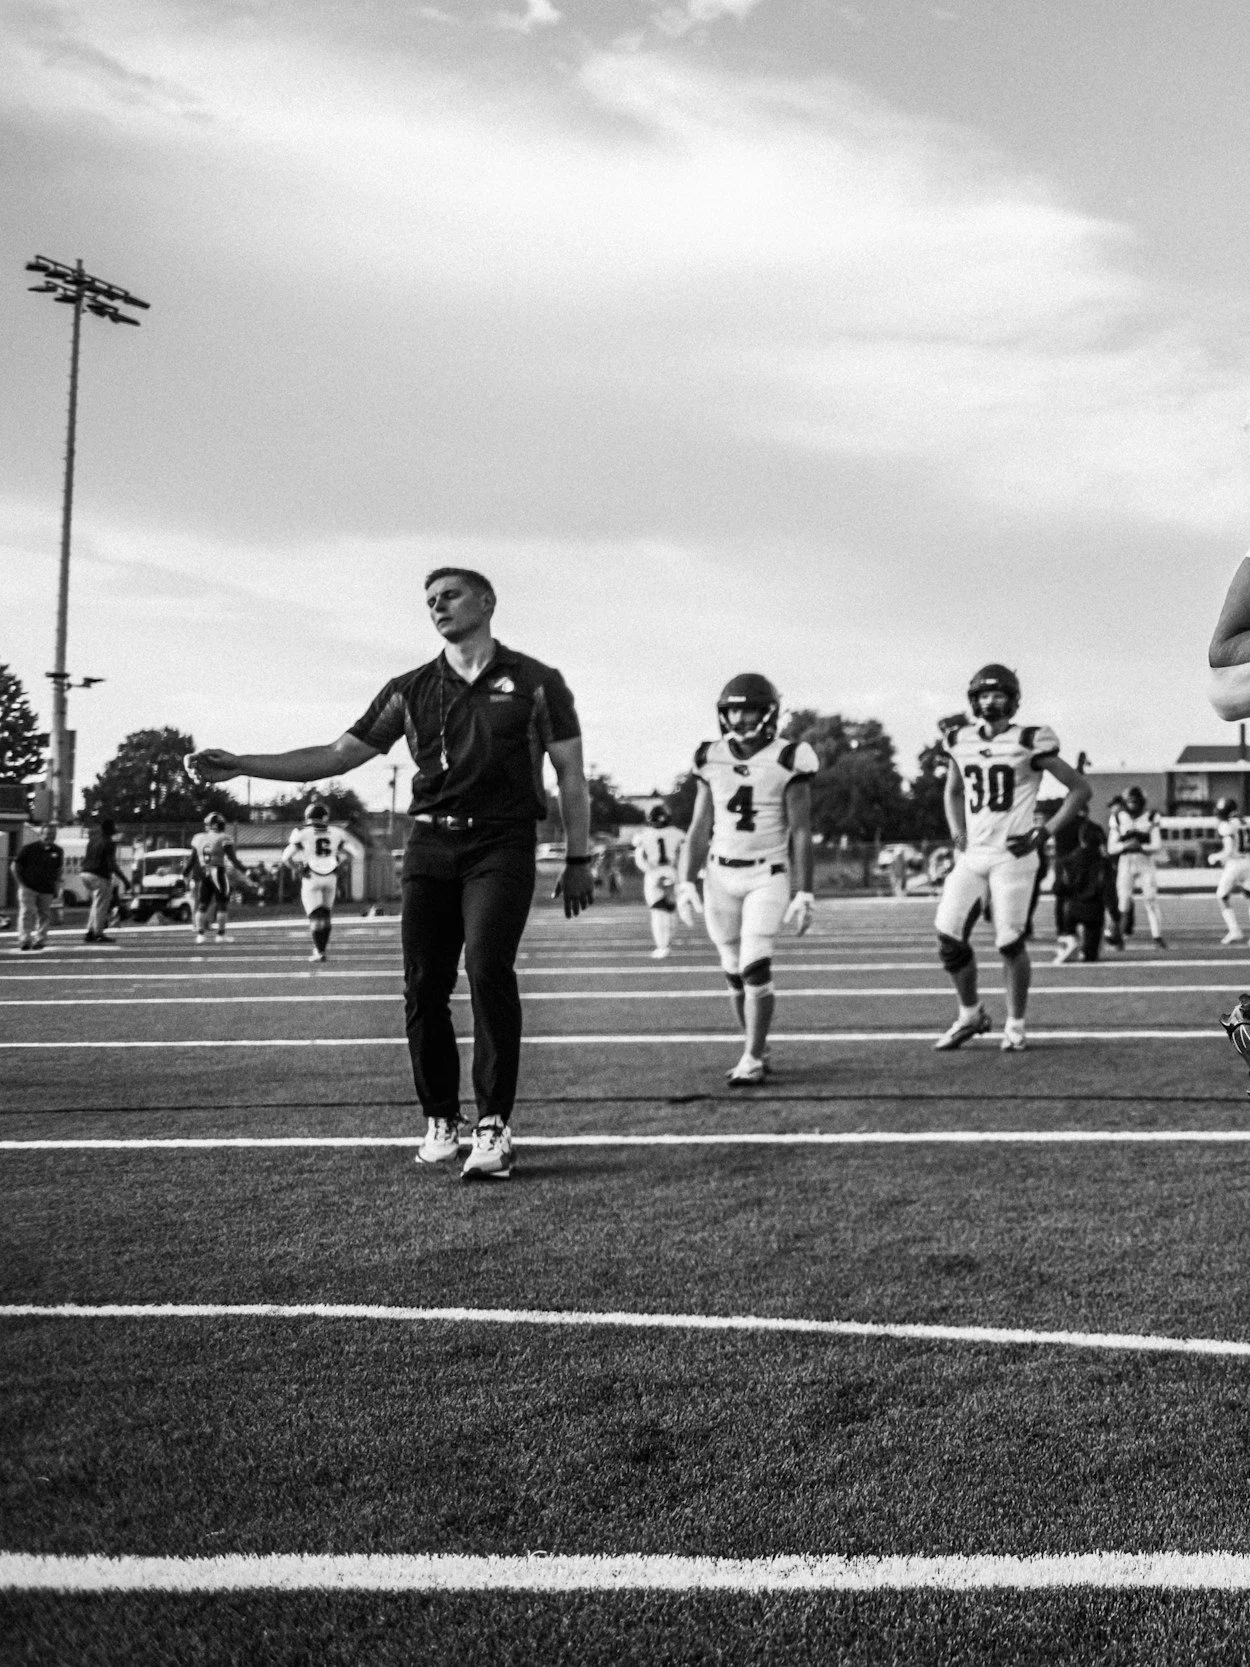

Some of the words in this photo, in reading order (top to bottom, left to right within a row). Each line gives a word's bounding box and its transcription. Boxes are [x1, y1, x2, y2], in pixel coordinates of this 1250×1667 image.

[727, 786, 758, 831] 4
[964, 764, 1015, 813] 30
[657, 838, 668, 865] 1
